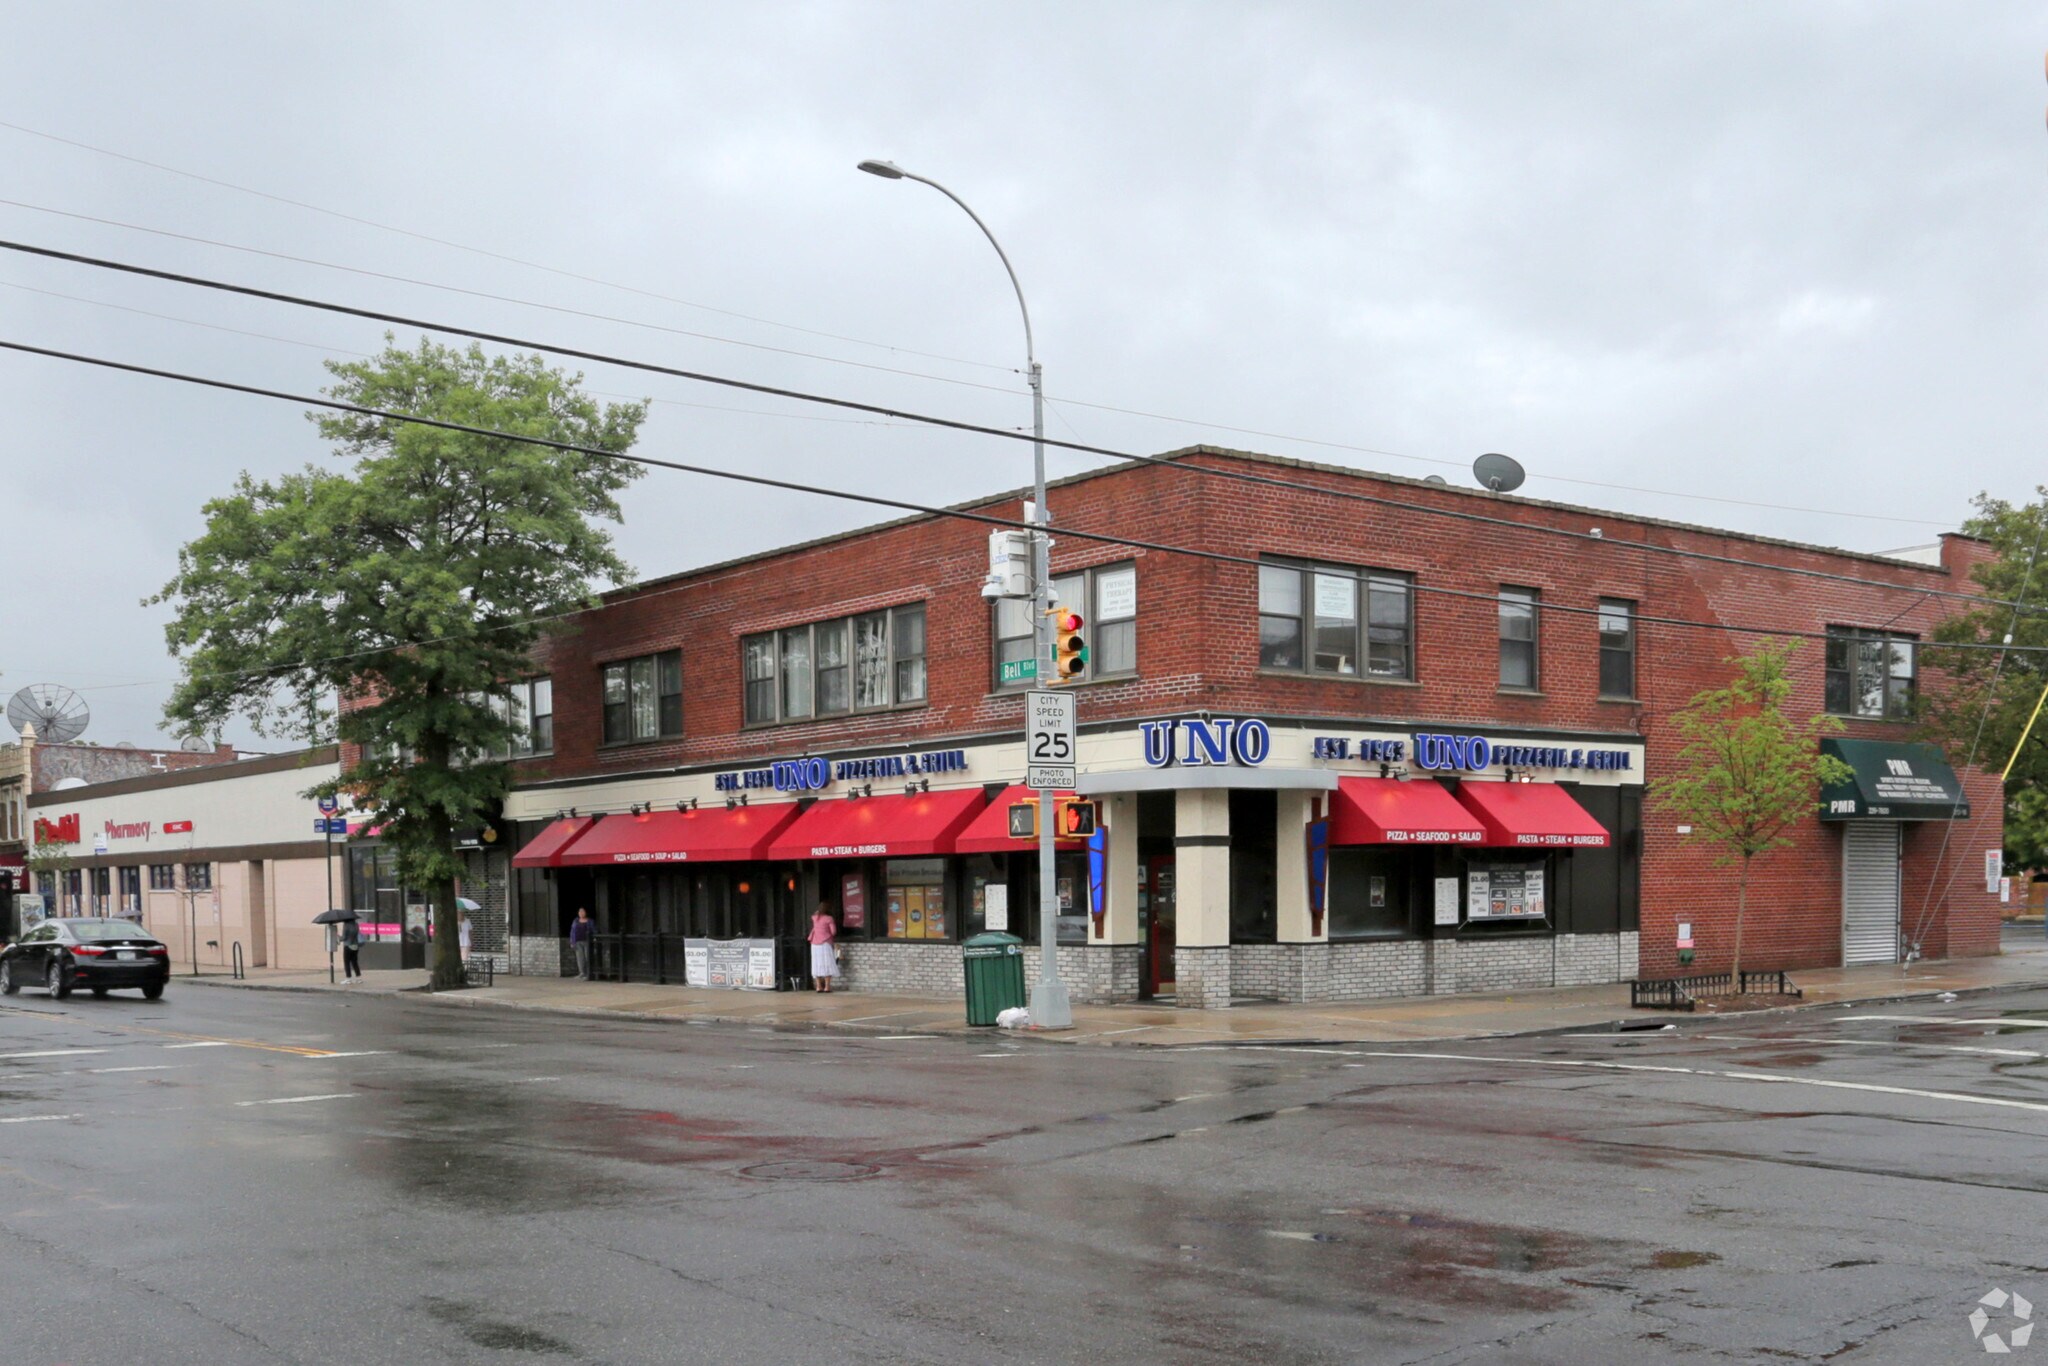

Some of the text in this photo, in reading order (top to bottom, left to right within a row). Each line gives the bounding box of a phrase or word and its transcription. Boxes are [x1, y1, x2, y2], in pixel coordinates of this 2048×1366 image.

[1004, 658, 1035, 678] Bell Blvd
[1040, 696, 1060, 704] CITY
[1036, 707, 1064, 716] SPEED
[1039, 719, 1061, 727] LIMIT
[1034, 731, 1069, 758] 25
[1139, 719, 1271, 768] UNO
[1360, 738, 1406, 761] 1943
[1411, 733, 1491, 770] UNO
[1492, 745, 1568, 768] PIZZERIA
[1571, 749, 1585, 768] &
[1587, 750, 1633, 770] GRILL
[743, 769, 773, 789] 1943
[771, 757, 830, 792] UNO
[837, 757, 902, 780] PIZZERIA
[905, 755, 919, 775] &
[921, 750, 968, 772] GRILL
[1039, 769, 1064, 777] PHOTO
[1886, 759, 1913, 776] PMR
[1032, 777, 1072, 785] ENFORCED
[1831, 800, 1856, 813] PMR
[105, 819, 151, 842] Pharmacy
[1386, 831, 1482, 841] PIZZA SEAFOOD SALAD
[1517, 835, 1604, 845] PASTA STEAK BURGERS
[655, 852, 667, 860] SOUP
[671, 852, 687, 860] SALAD
[811, 844, 886, 856] PASTA STEAK BURGERS
